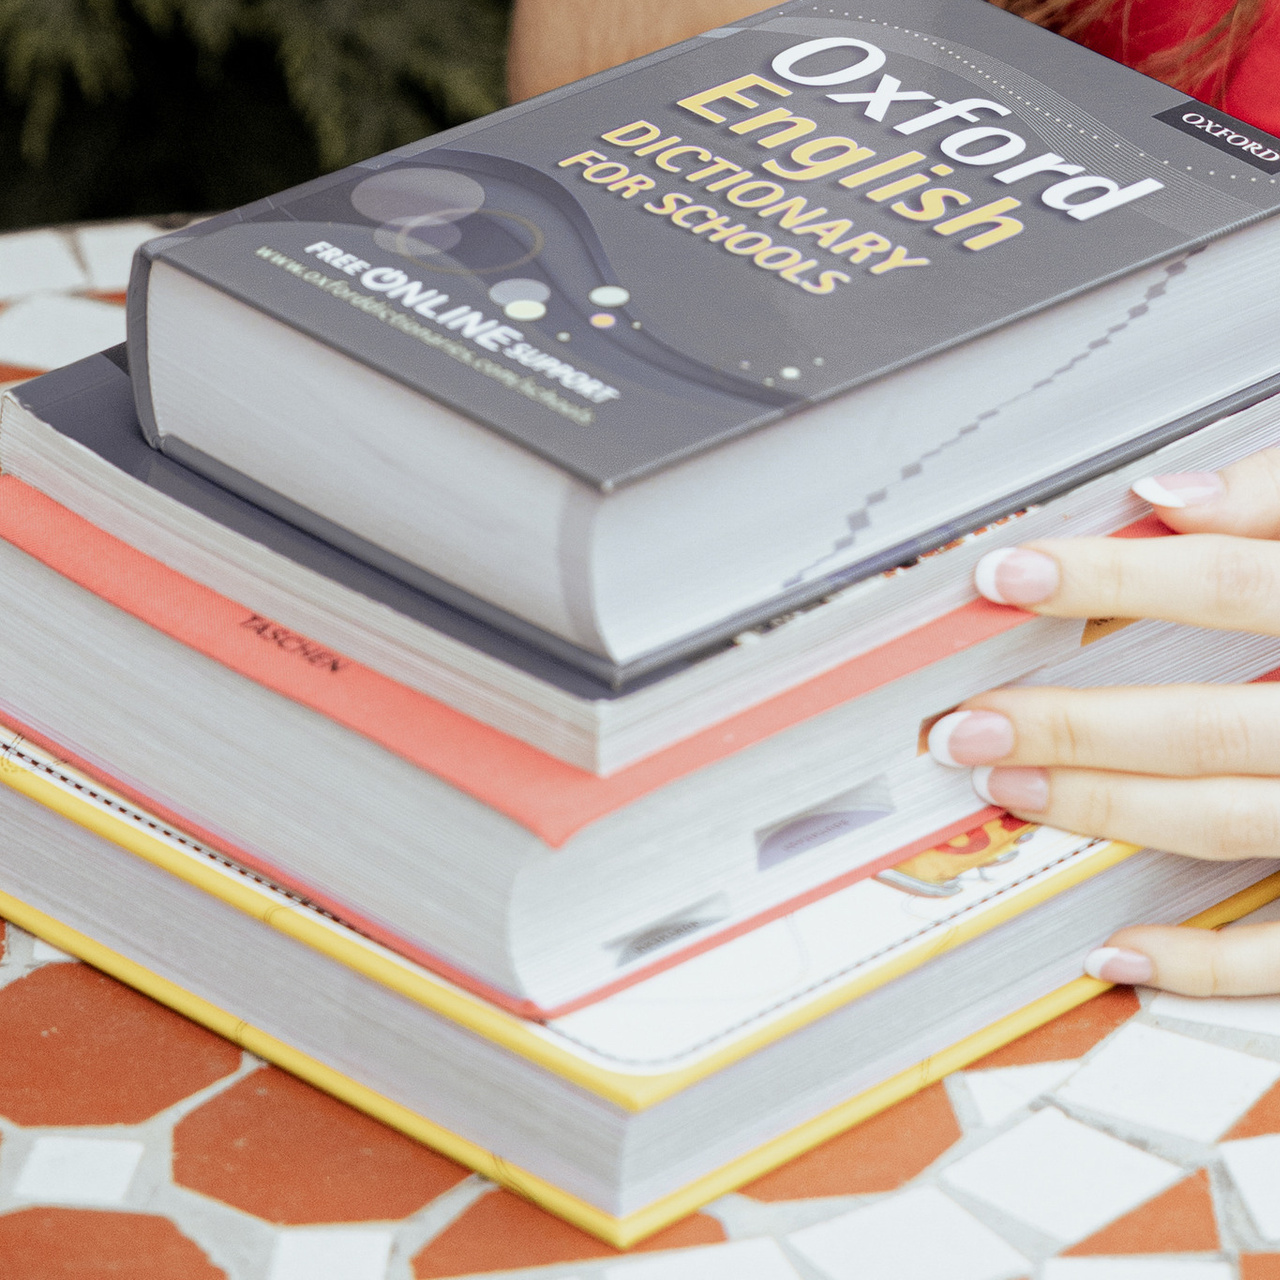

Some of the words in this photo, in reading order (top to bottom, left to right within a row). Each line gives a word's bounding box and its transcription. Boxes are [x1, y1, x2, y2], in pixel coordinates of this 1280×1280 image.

[600, 119, 931, 275] DICTIONARY
[676, 72, 1025, 251] English
[771, 36, 1165, 221] Oxford
[1181, 112, 1280, 162] OXFORD
[557, 149, 657, 199] FOR
[644, 191, 851, 295] SCHOOLS
[303, 240, 372, 277] FREE
[360, 266, 525, 353] ONLINE
[502, 342, 621, 404] SUPPORT
[240, 612, 349, 673] TASCHEN
